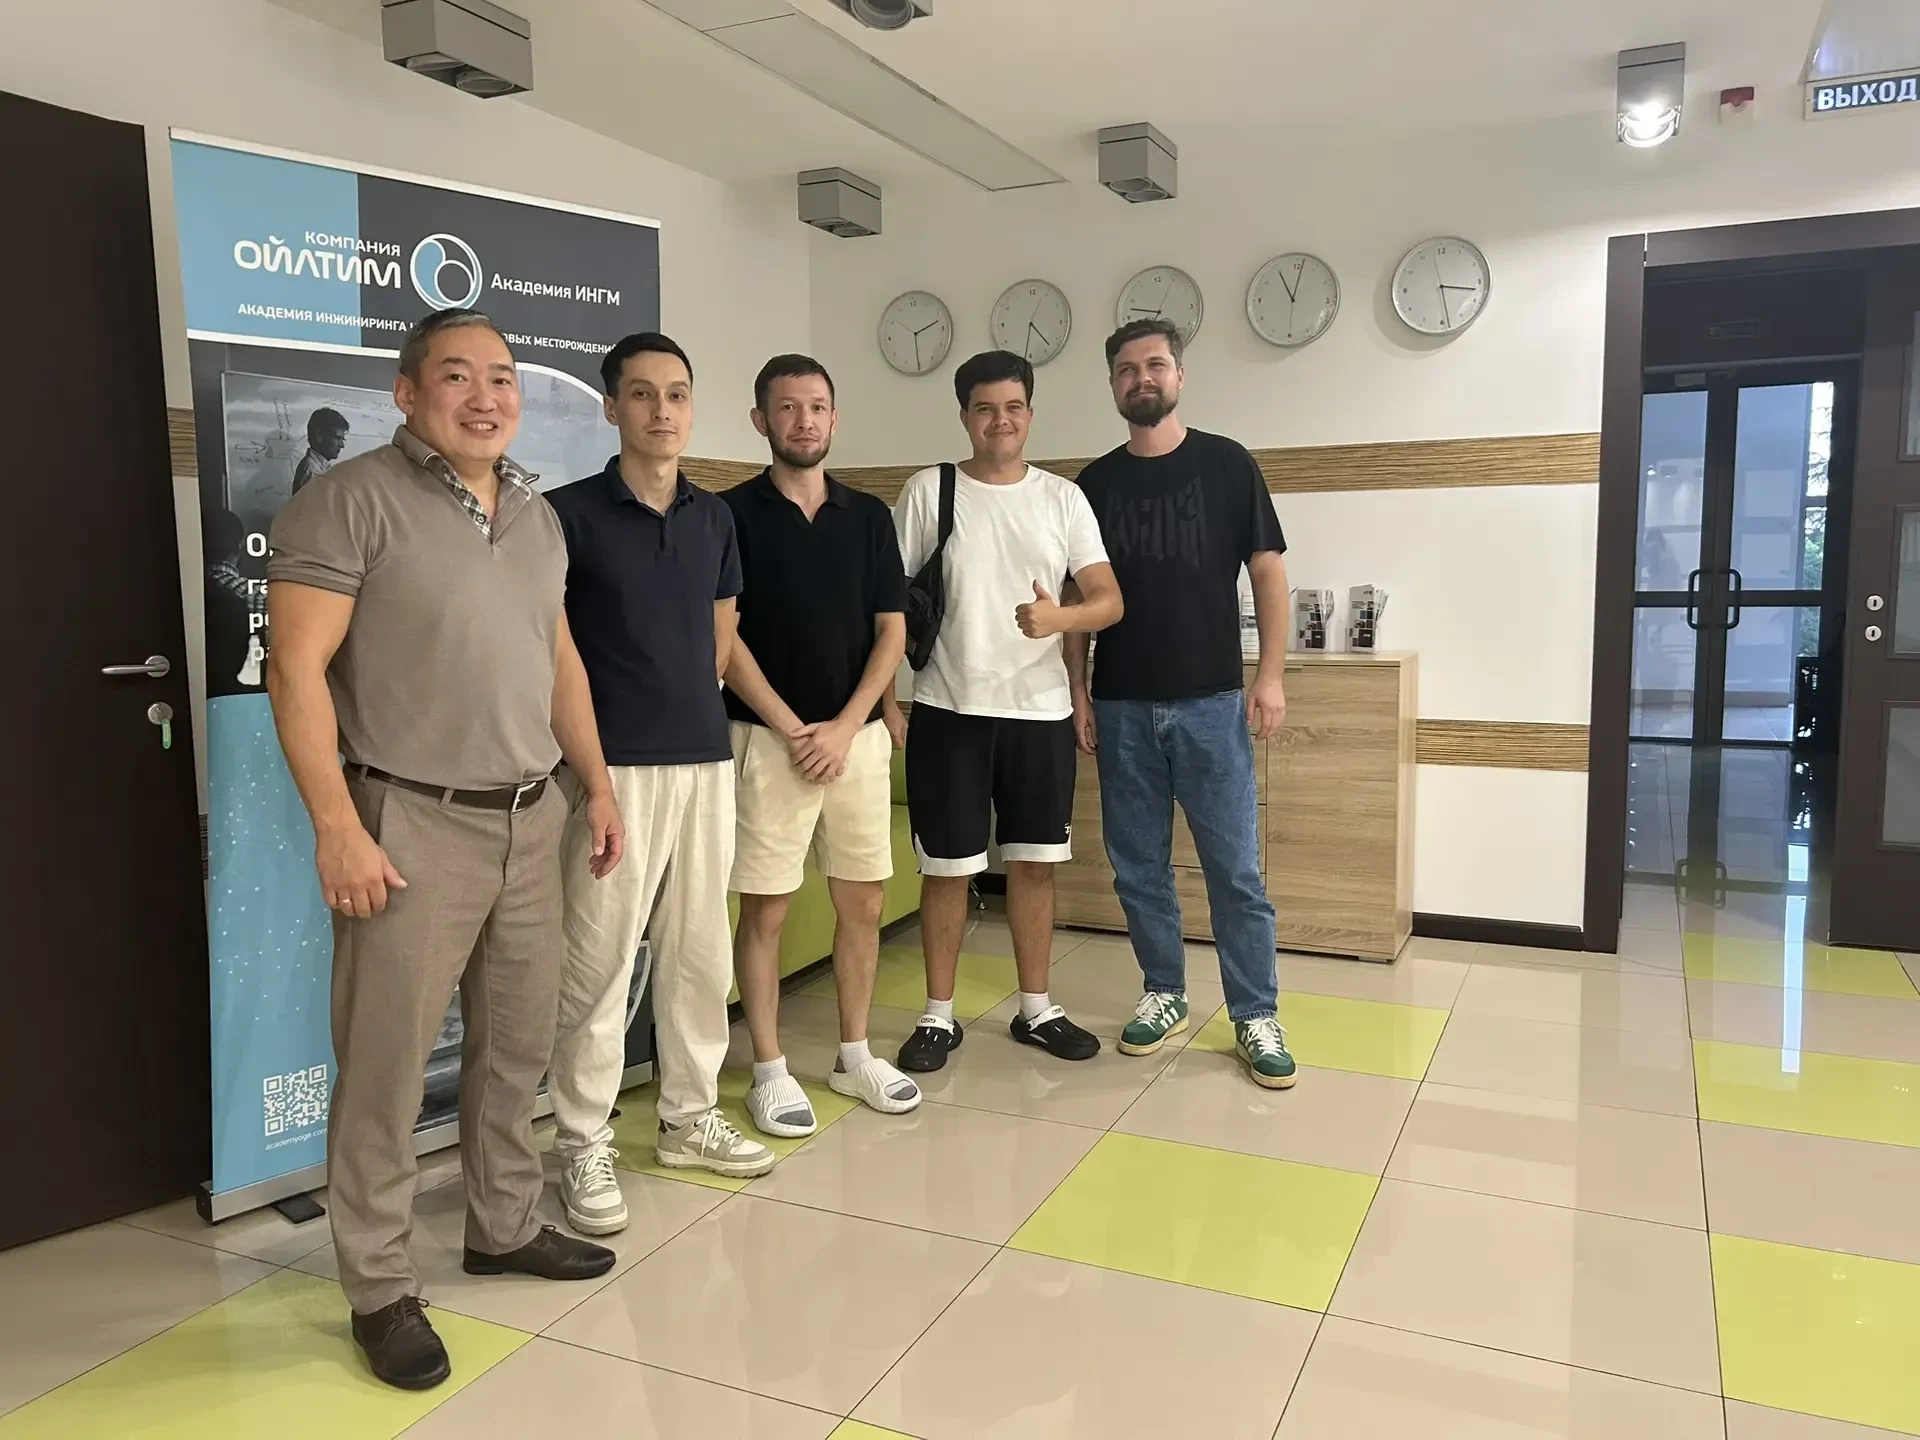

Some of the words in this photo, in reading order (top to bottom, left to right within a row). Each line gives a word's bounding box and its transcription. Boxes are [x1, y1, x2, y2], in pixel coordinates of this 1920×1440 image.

[1817, 78, 1917, 110] ВЫХОД
[305, 231, 401, 257] КОМПАНИЯ
[1437, 247, 1446, 255] 12
[234, 235, 401, 289] ОЙЛТИМ
[491, 273, 571, 299] Академия
[575, 285, 620, 306] ИНГМ
[238, 303, 313, 321] АКАДЕМИЯ
[315, 312, 407, 332] ИНЖИНИРИНГА
[534, 336, 616, 355] МЕСТОРОЖДЕНИ
